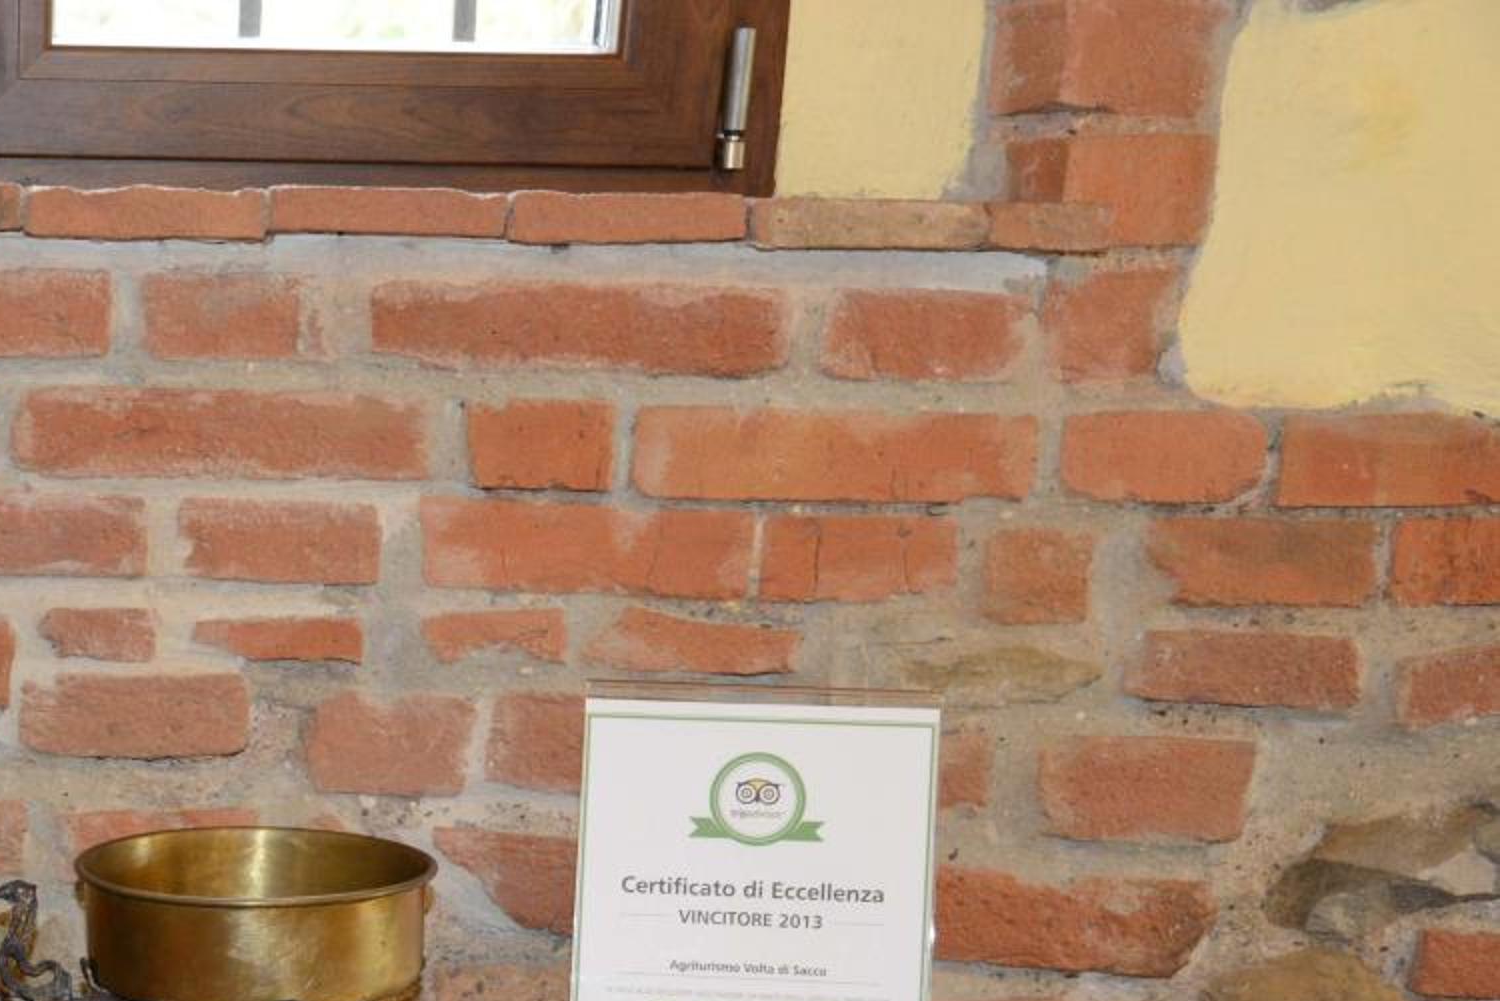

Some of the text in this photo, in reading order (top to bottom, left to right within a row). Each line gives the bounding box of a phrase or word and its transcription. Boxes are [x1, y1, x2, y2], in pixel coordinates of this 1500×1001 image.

[620, 876, 886, 904] Certificato di Eccellenza
[678, 909, 823, 930] VINCITORE 2013
[669, 959, 742, 974] Agriturismo
[743, 962, 776, 976] Volta
[777, 964, 790, 976] di
